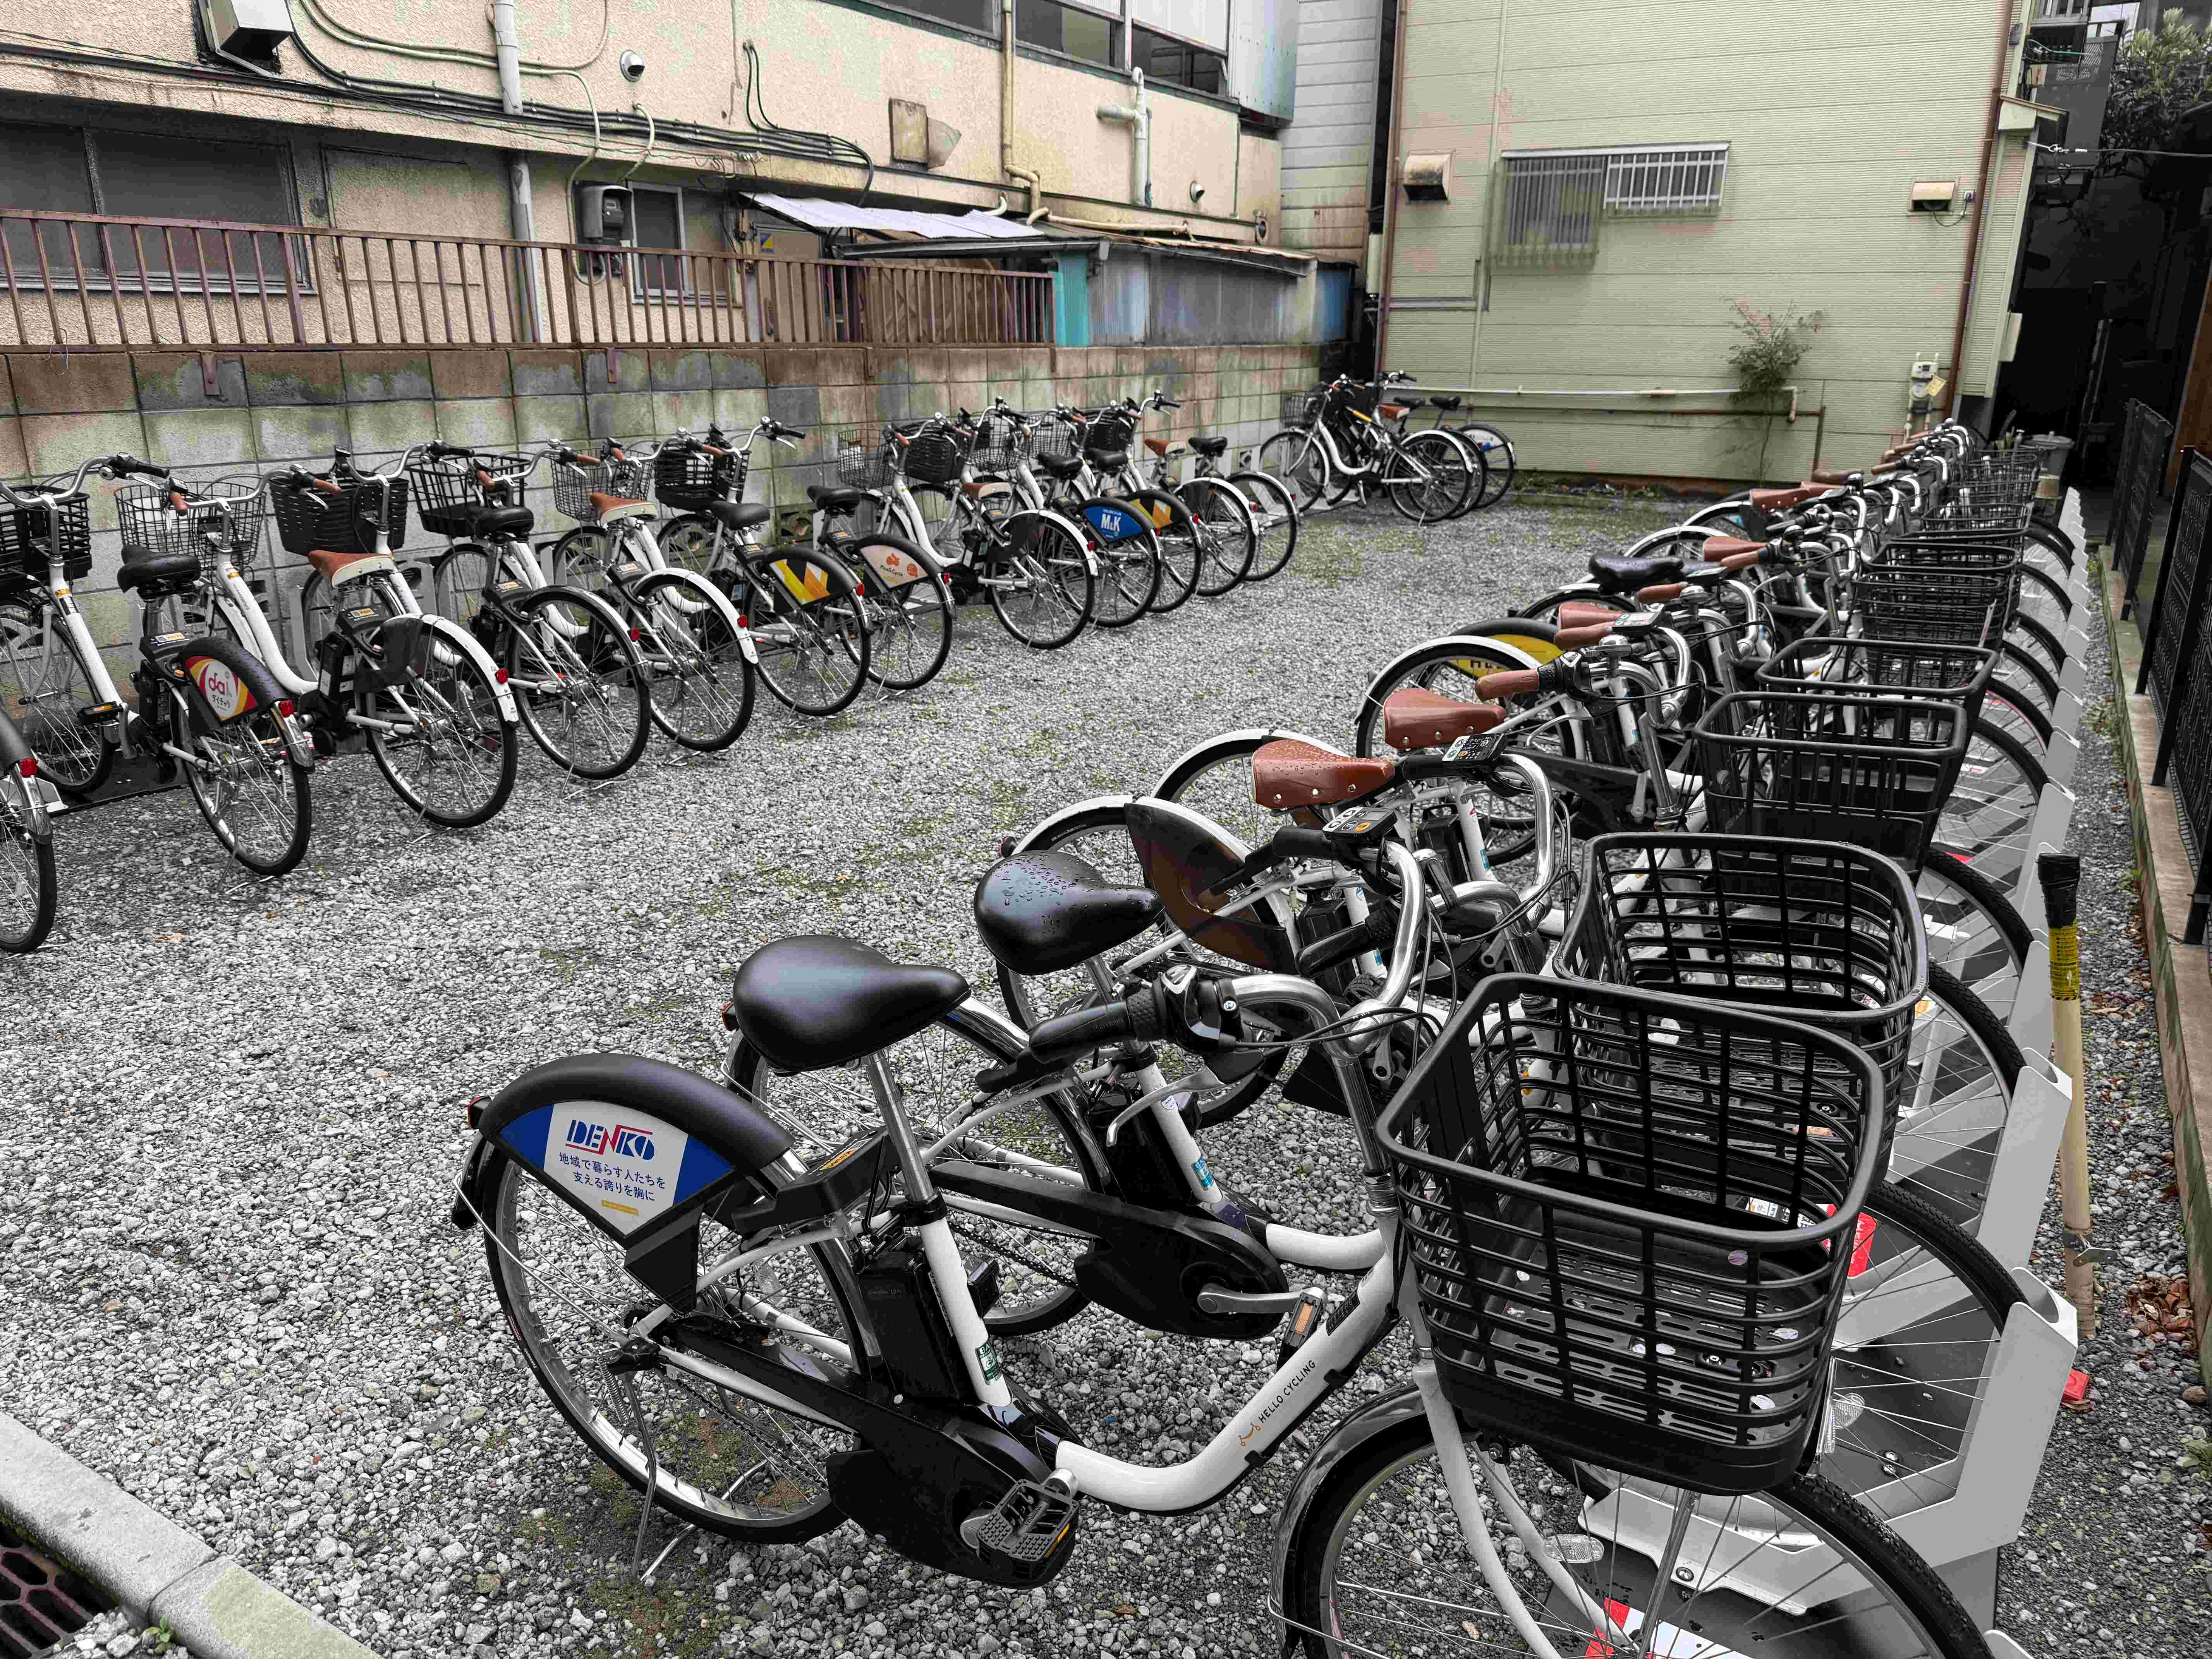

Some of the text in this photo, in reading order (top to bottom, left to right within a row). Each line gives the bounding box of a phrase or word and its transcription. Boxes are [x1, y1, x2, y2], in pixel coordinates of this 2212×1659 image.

[565, 1120, 655, 1161] DENKO
[558, 1152, 665, 1189] 地域で暮らす人たちを
[573, 1171, 655, 1201] 支える誇りを胸に
[1258, 1360, 1316, 1423] HELLO CYCLING
